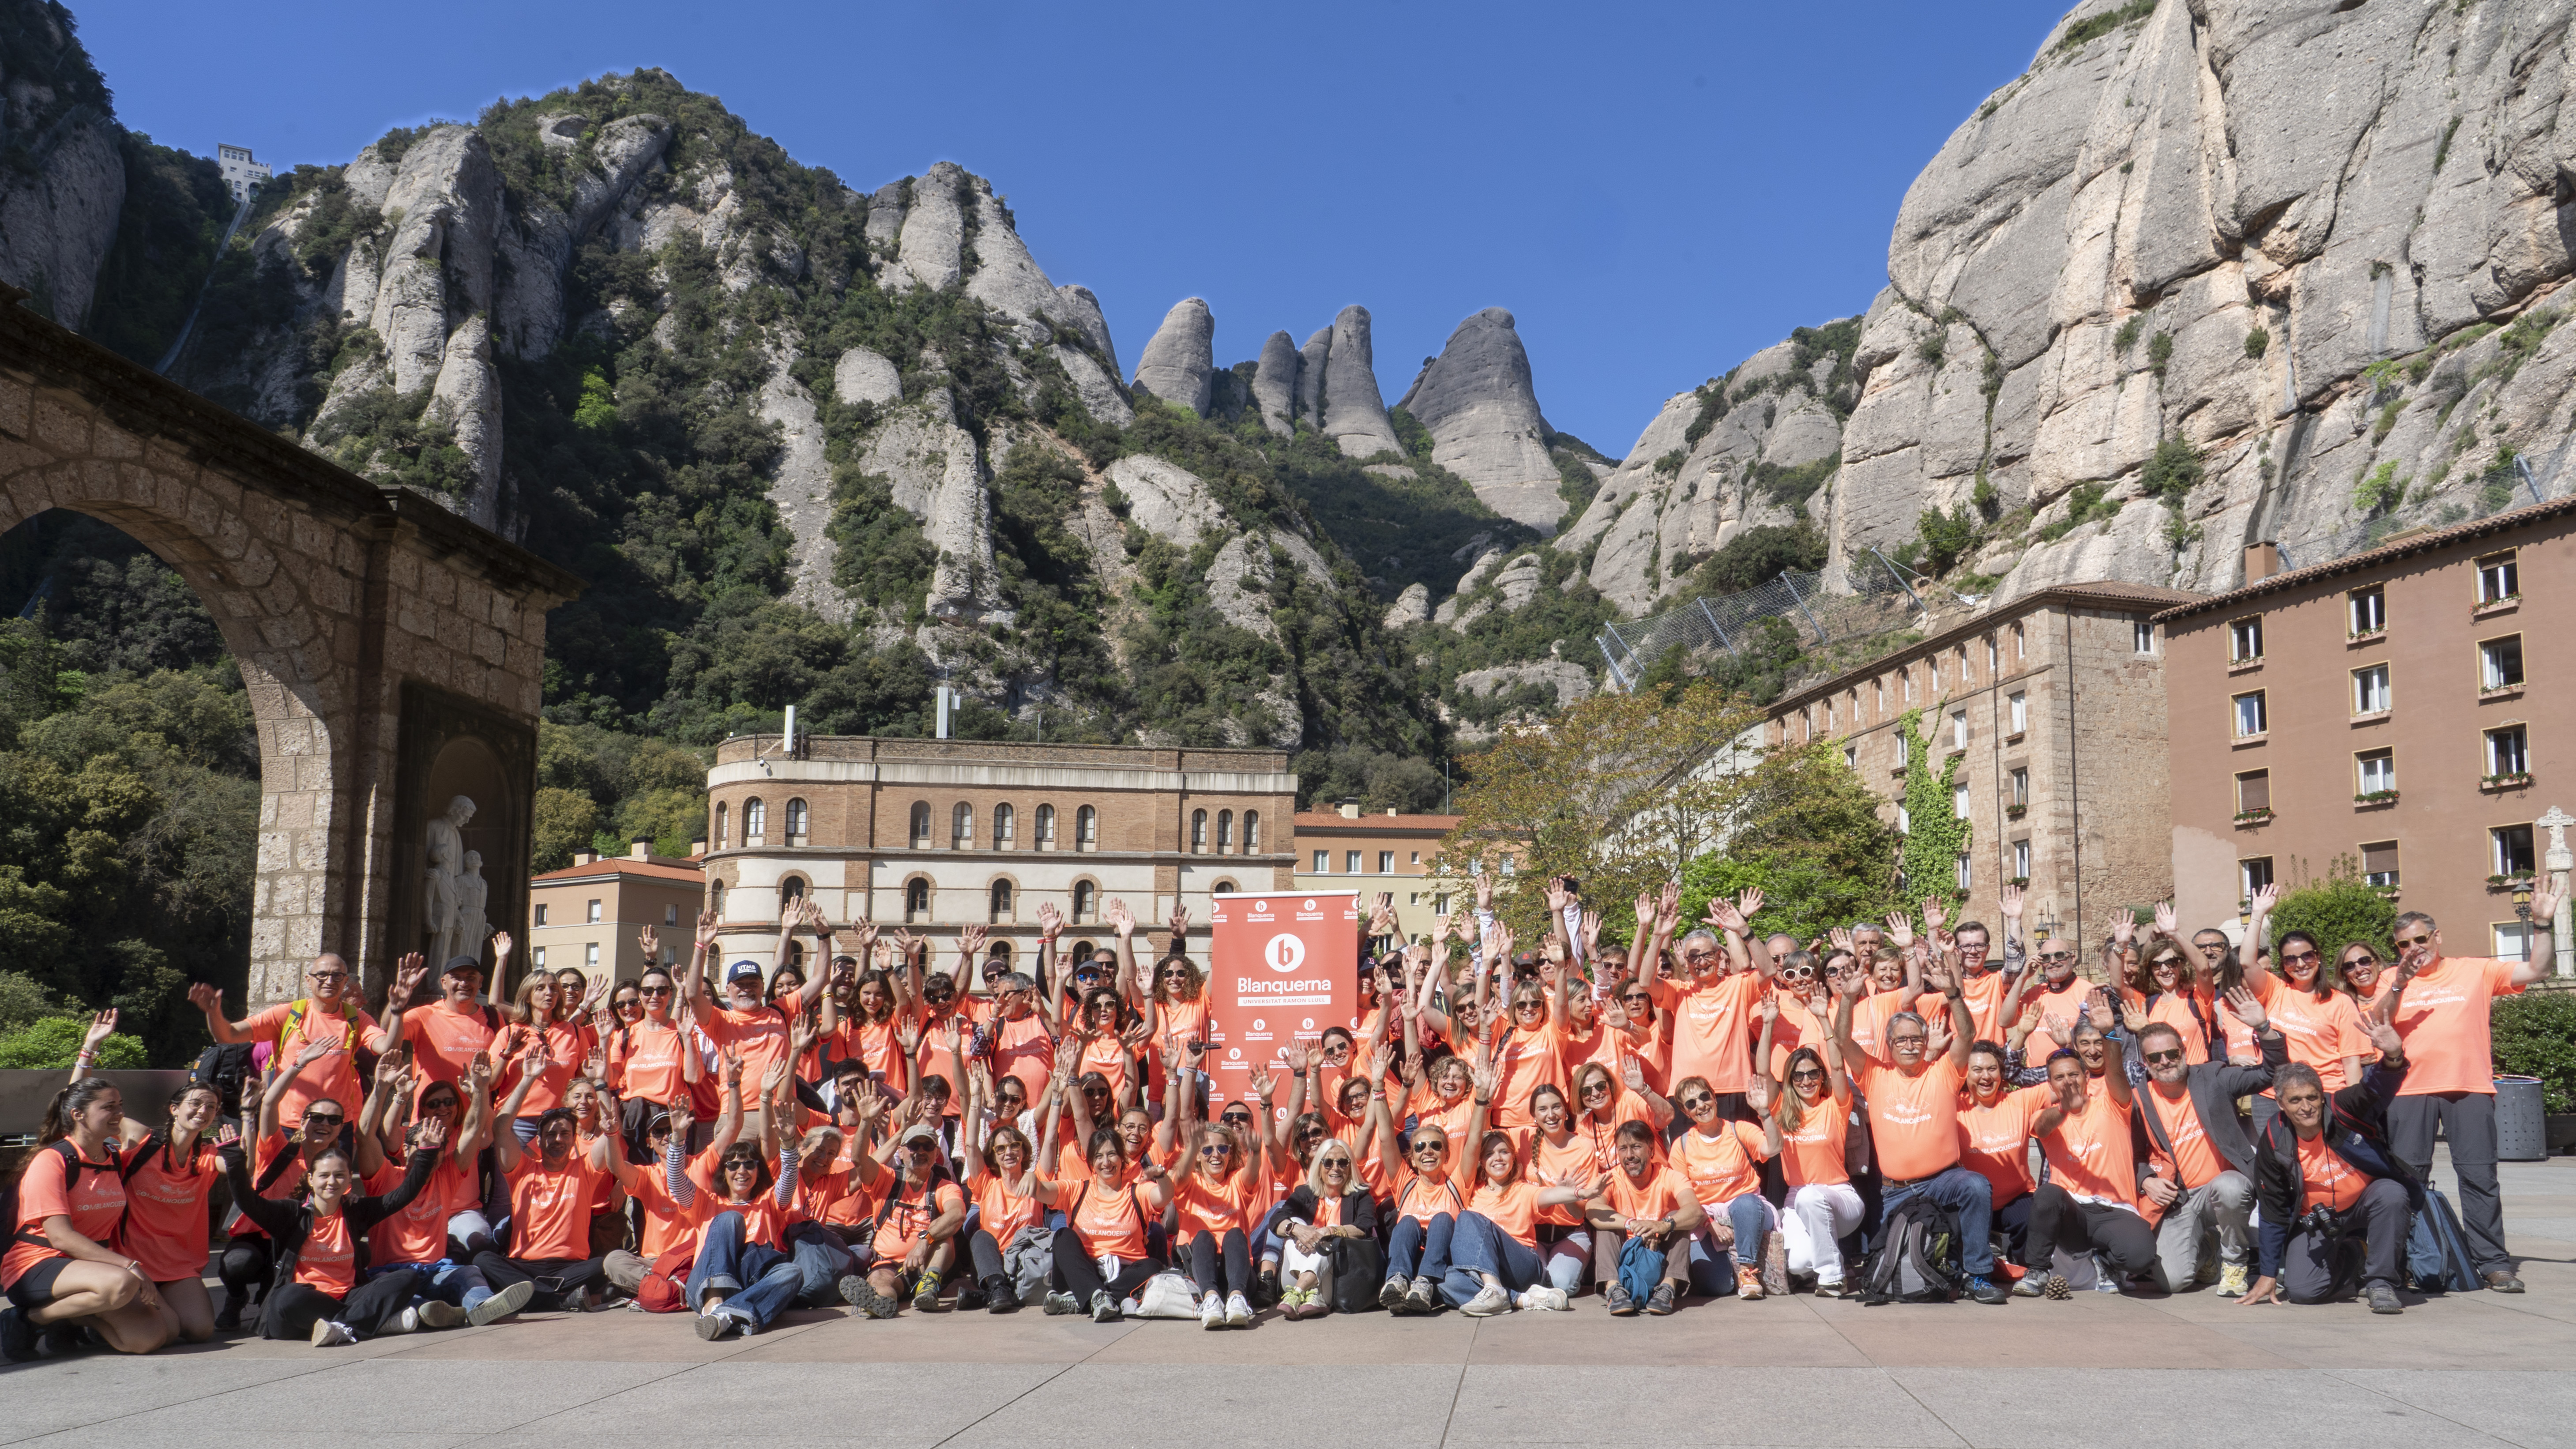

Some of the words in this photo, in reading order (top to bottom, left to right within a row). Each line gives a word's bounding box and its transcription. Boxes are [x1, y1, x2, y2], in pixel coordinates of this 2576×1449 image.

[1278, 938, 1294, 967] b
[1238, 977, 1331, 994] Blanquerna
[2402, 996, 2466, 1009] SOMBLANQUERNA
[628, 1061, 677, 1070] SOMBLANQUERNA
